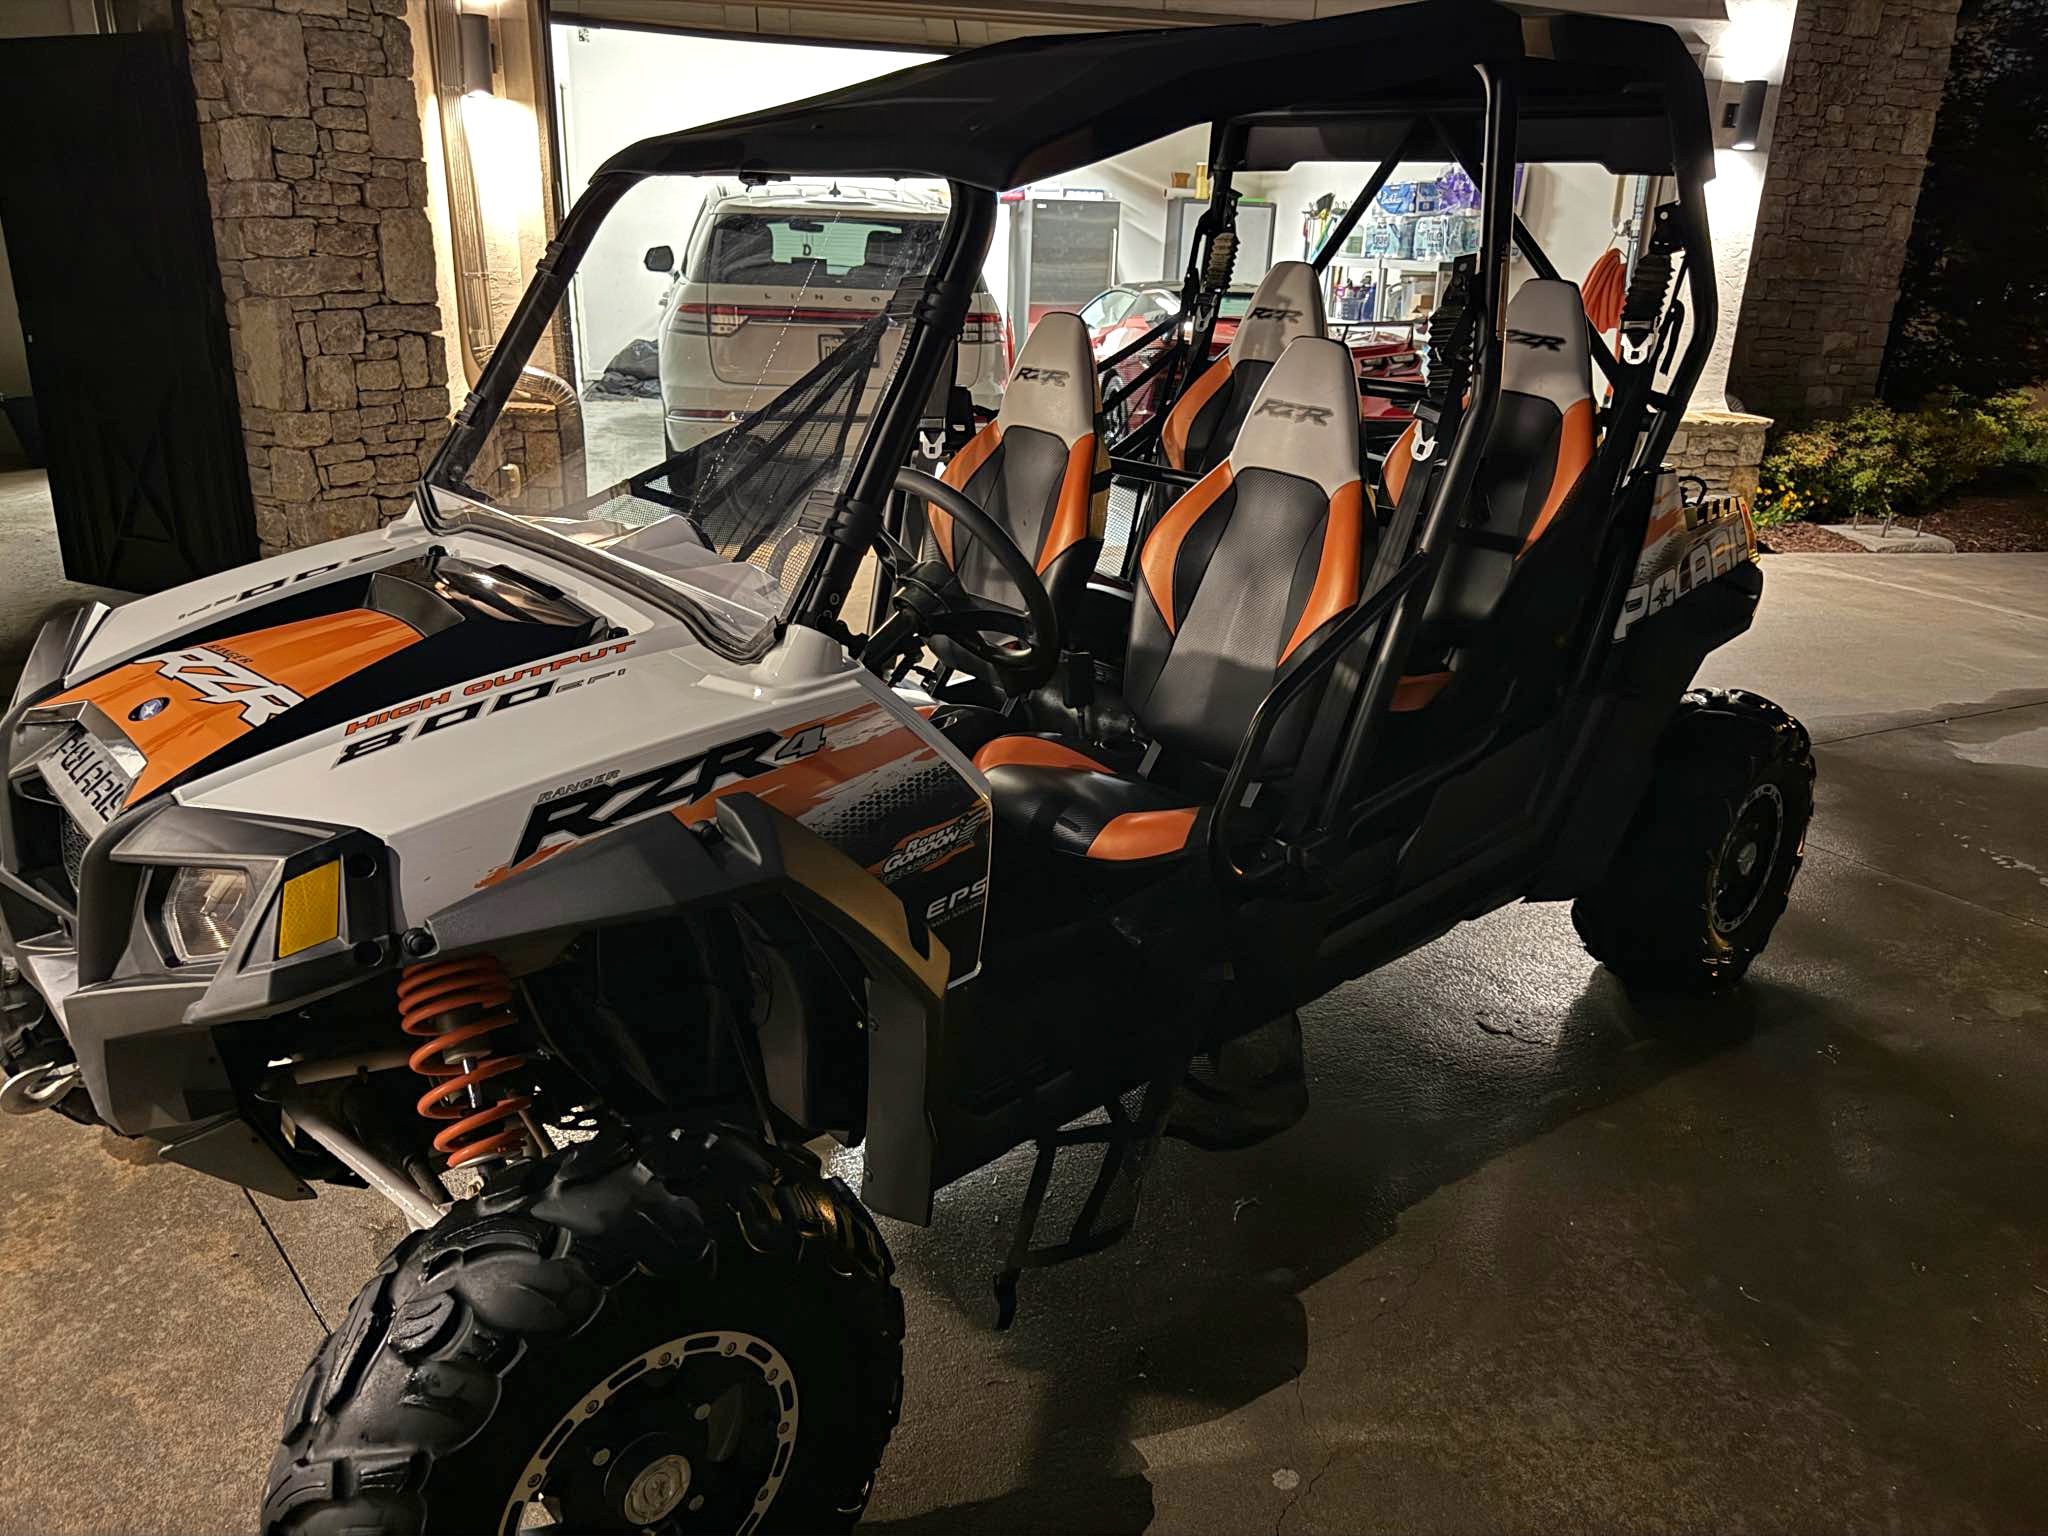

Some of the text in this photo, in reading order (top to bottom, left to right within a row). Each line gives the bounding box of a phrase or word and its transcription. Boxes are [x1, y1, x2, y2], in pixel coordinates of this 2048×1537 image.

[1254, 399, 1334, 427] RZR
[132, 646, 306, 728] RZR
[344, 640, 637, 737] HIGH OUTPUT
[537, 769, 622, 803] RANGER
[883, 829, 961, 873] GORDON
[926, 875, 989, 920] EPS
